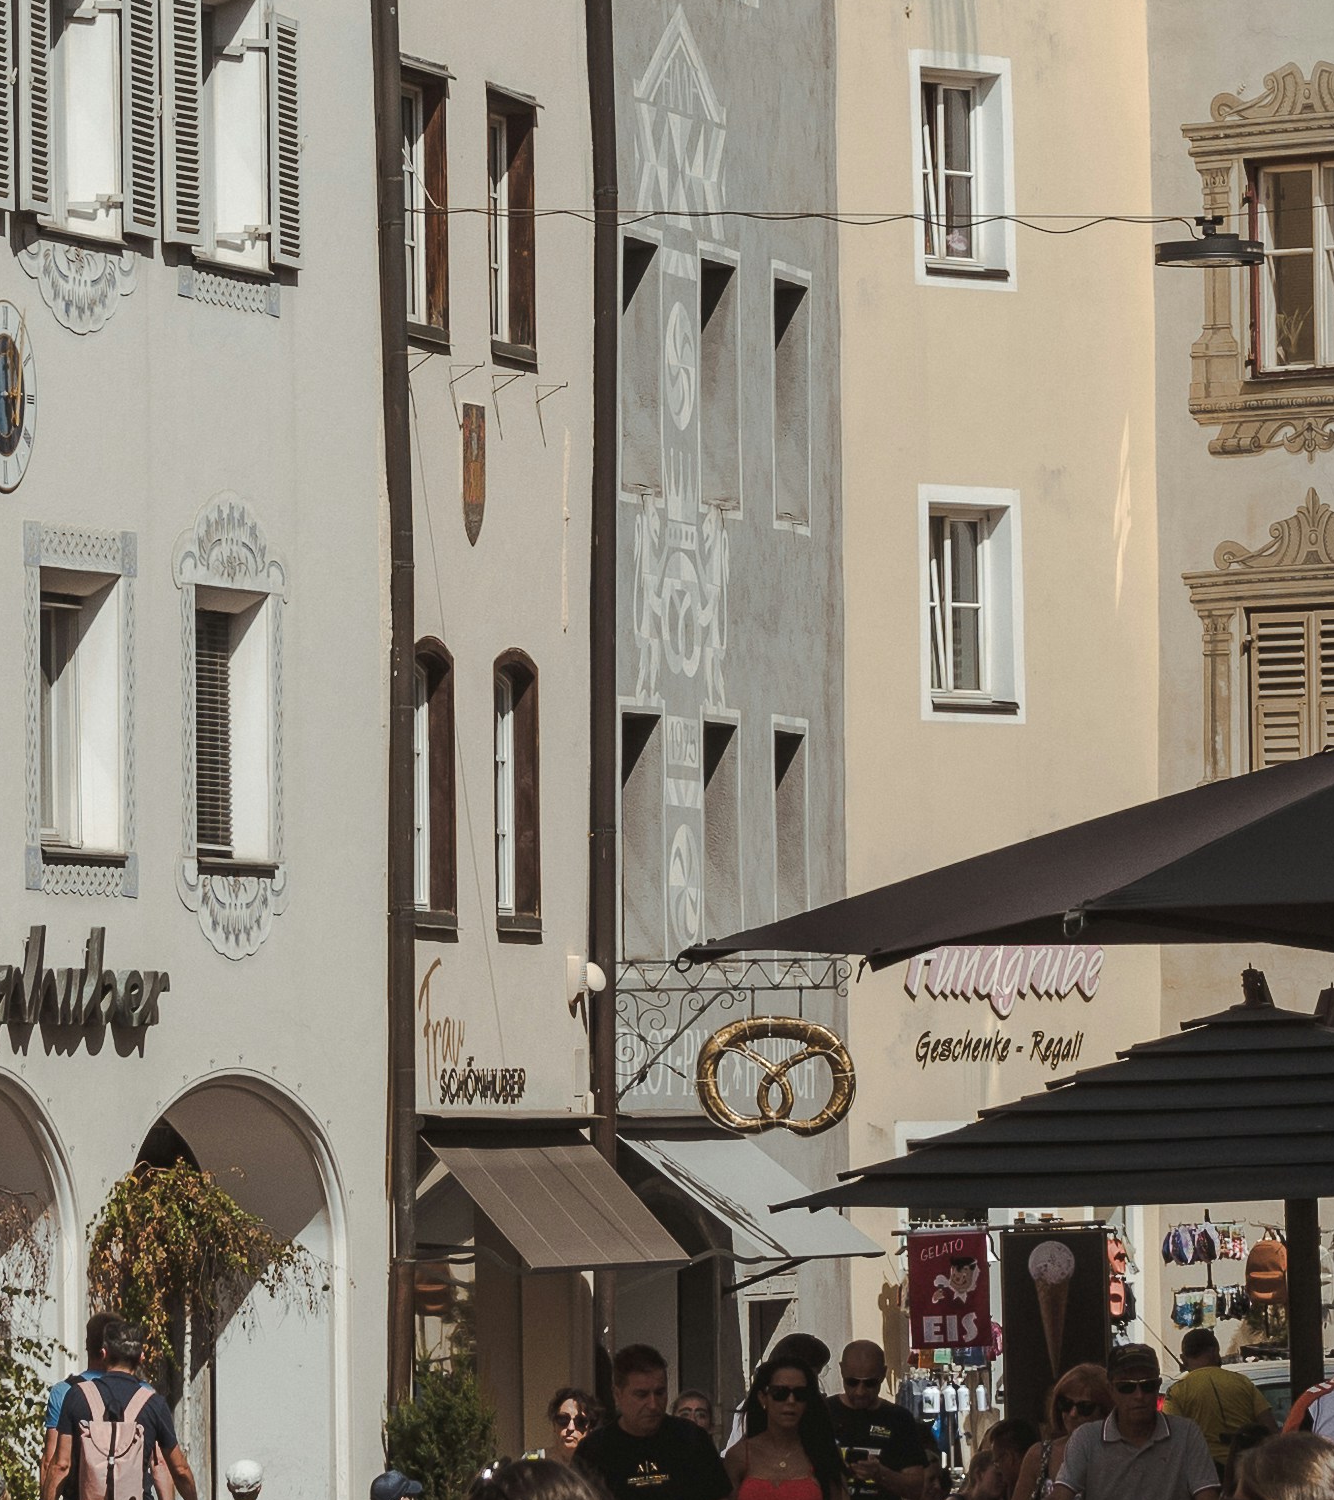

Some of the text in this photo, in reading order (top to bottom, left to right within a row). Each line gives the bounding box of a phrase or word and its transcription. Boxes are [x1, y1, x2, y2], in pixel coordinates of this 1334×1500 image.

[418, 957, 465, 1105] Frau
[915, 1030, 1012, 1070] Geschenke
[440, 1056, 526, 1105] SCHÖNHUBER
[920, 1238, 964, 1260] GELATO
[922, 1312, 978, 1342] EIS
